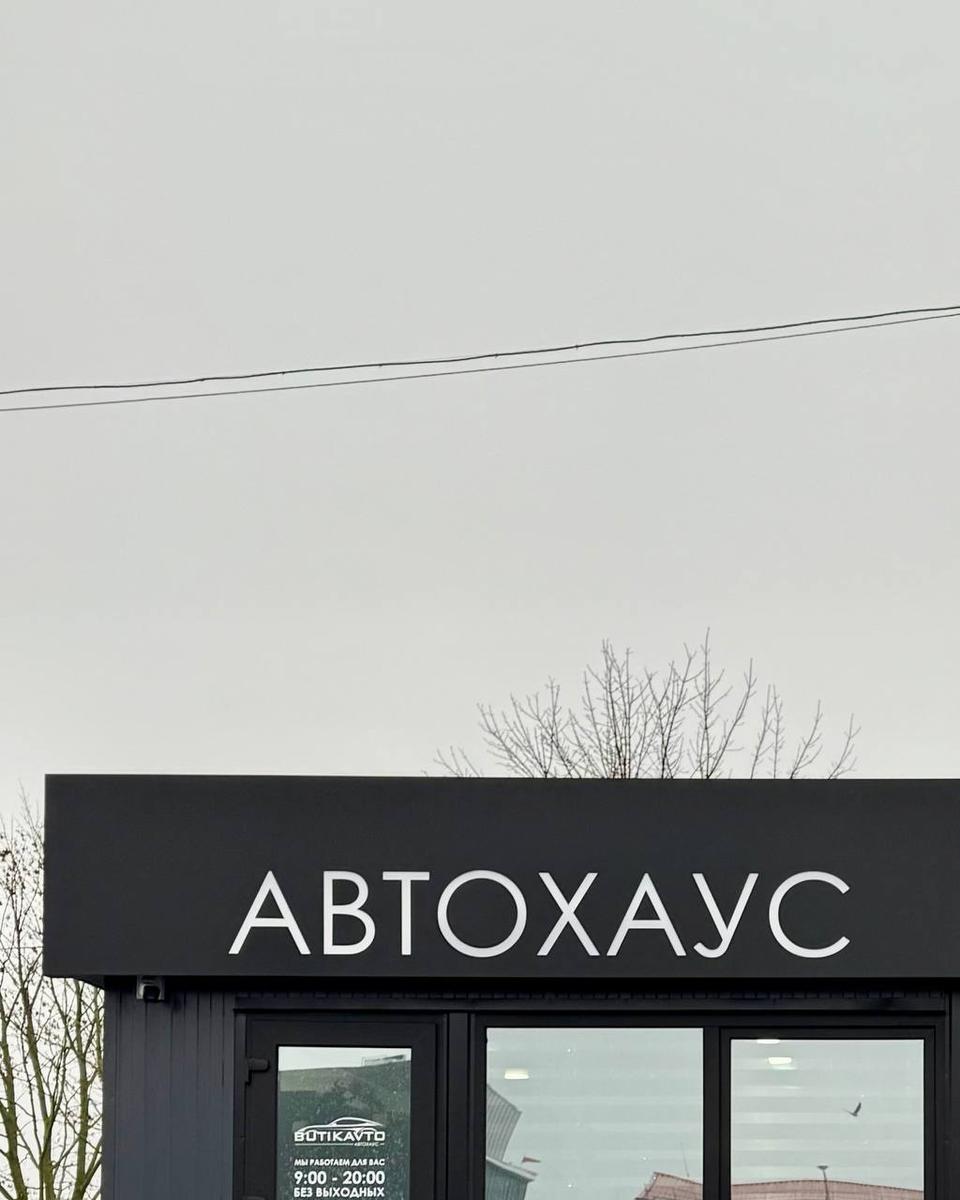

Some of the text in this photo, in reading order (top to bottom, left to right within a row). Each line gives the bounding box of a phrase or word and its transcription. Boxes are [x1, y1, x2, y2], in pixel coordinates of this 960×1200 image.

[228, 870, 851, 958] АВТОХАУС
[294, 1131, 386, 1142] BUTIKAVTO
[350, 1159, 367, 1167] ДЛЯ
[294, 1170, 327, 1185] 9:00
[342, 1170, 386, 1185] 20:00
[293, 1187, 385, 1198] БЕЗ ВЫХОДНЫХ
